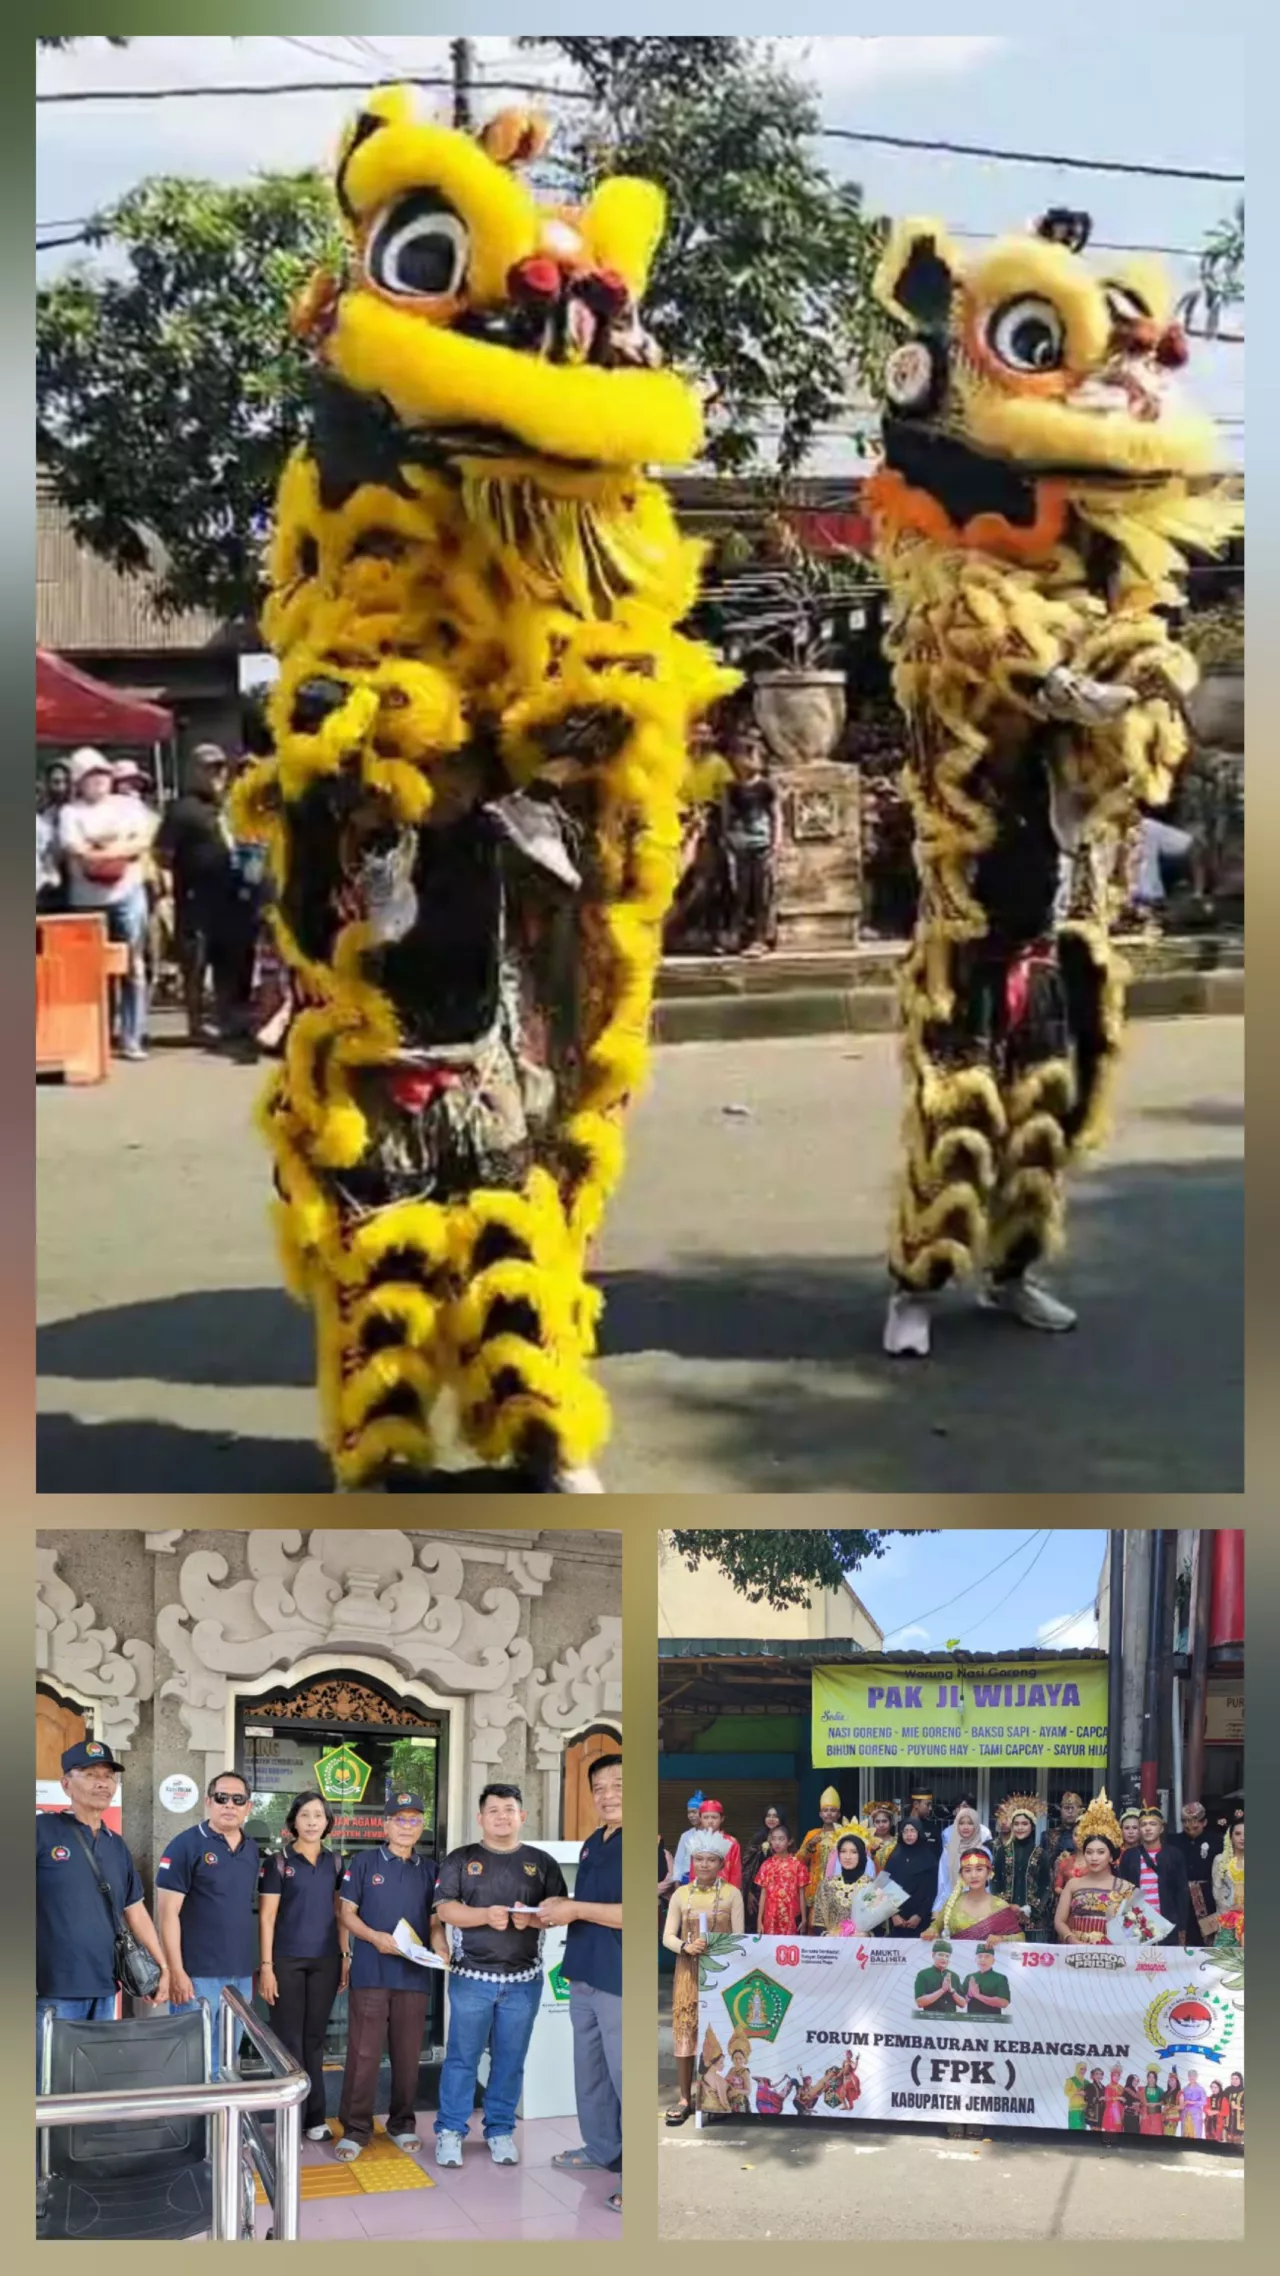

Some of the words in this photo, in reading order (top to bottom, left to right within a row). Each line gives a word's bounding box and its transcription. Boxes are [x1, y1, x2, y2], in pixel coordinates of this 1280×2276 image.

[905, 1669, 954, 1680] Warung
[957, 1667, 985, 1678] Nasi
[988, 1668, 1037, 1679] Goreng
[868, 1685, 923, 1708] PAK
[936, 1685, 959, 1708] JI
[973, 1683, 1081, 1708] WIJAYA
[828, 1727, 851, 1738] NASI
[853, 1727, 892, 1738] GORENG
[902, 1727, 919, 1738] MIE
[922, 1727, 961, 1738] GORENG
[971, 1726, 1004, 1738] BAKSO
[1007, 1726, 1030, 1738] SAPI
[1039, 1726, 1067, 1737] AYAM
[826, 1744, 856, 1756] BIHUN
[859, 1744, 897, 1756] GORENG
[907, 1744, 947, 1755] PUYUNG
[950, 1744, 969, 1755] HAY
[979, 1744, 1002, 1755] TAMI
[1005, 1744, 1044, 1755] CAPCAY
[1053, 1744, 1086, 1756] SAYUR
[353, 1816, 383, 1828] AGAMA
[805, 2030, 869, 2046] FORUM
[873, 2033, 990, 2052] PEMBAURAN
[994, 2039, 1130, 2057] KEBANGSAAN
[891, 2091, 961, 2111] KABUPATEN
[965, 2096, 1035, 2114] JEMBRANA
